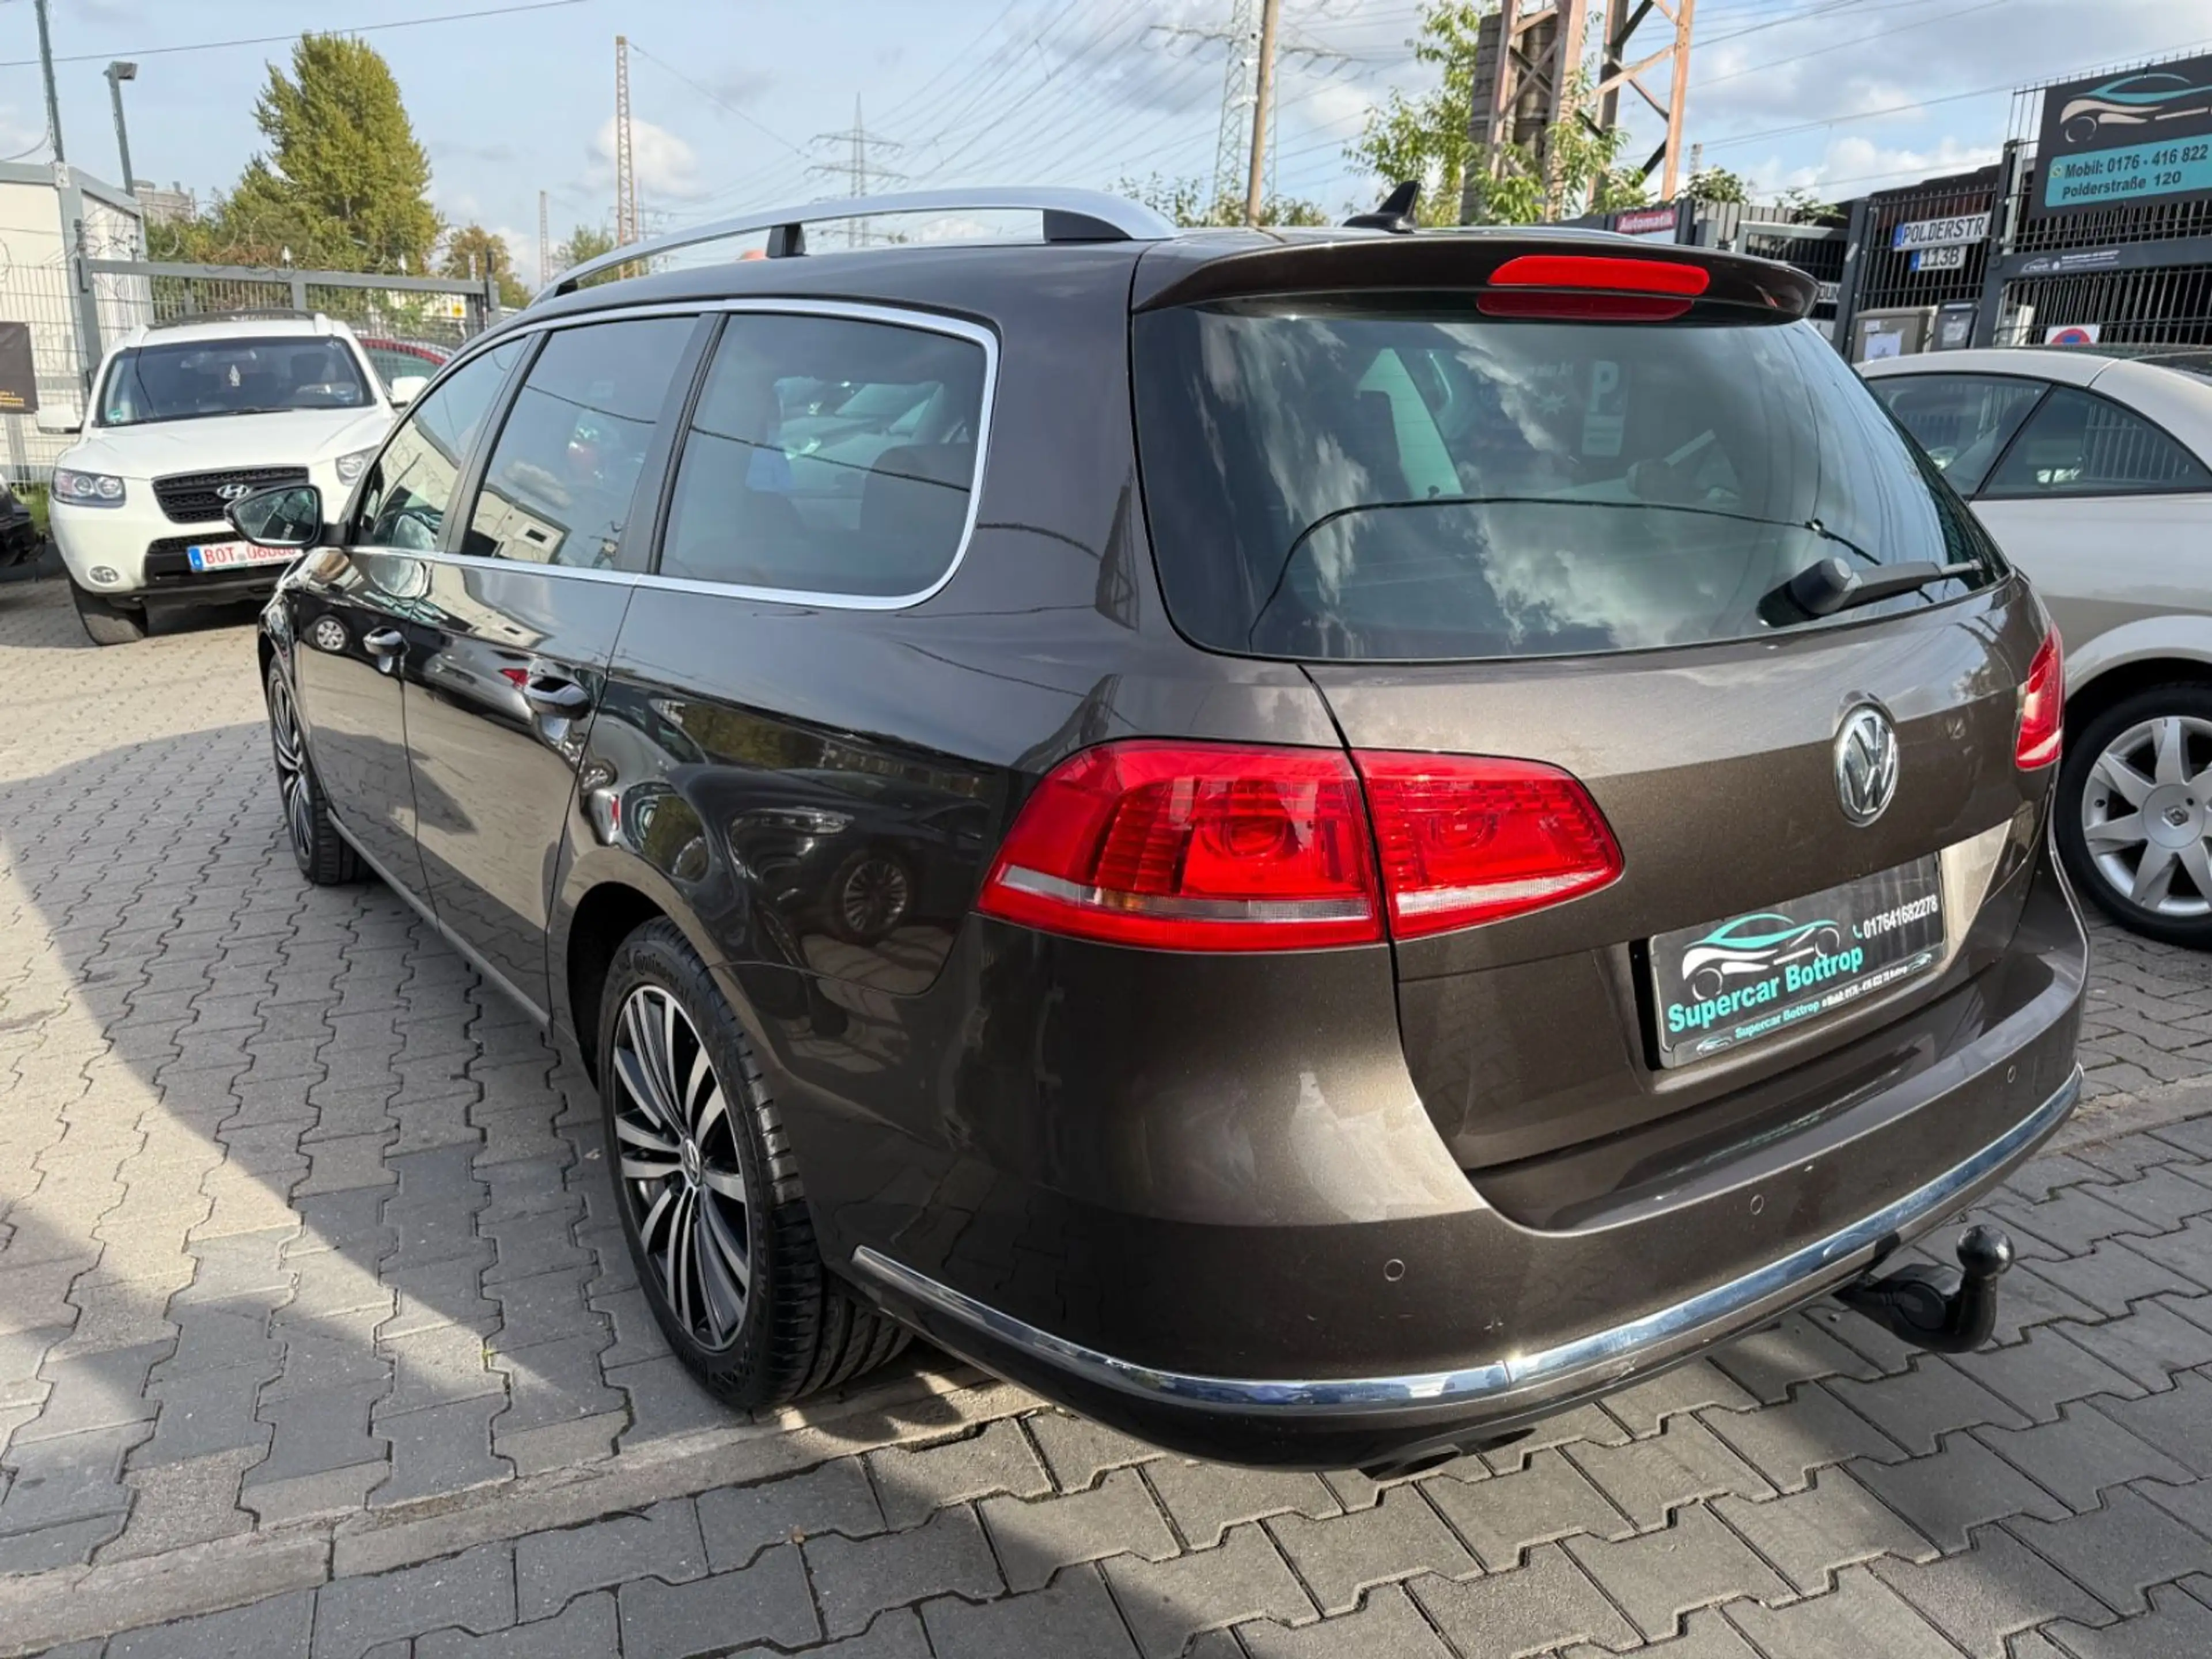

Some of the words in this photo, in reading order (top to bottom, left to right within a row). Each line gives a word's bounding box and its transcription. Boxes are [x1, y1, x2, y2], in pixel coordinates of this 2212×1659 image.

[2064, 159, 2103, 179] Mobil:
[2107, 154, 2140, 173] 0176
[2152, 148, 2177, 166] 416
[2181, 143, 2210, 162] 822
[2062, 175, 2146, 200] Polderstraße
[2153, 171, 2182, 187] 120
[1619, 211, 1673, 232] Automatik
[1902, 216, 1986, 244] POLDERSTR
[1921, 247, 1960, 267] 113B
[204, 546, 236, 565] BOT
[1862, 893, 1938, 939] 017641682278
[1668, 977, 1780, 1032] Supercar
[1785, 946, 1863, 993] Bottrop
[1734, 1014, 1781, 1039] Supercar
[1783, 1001, 1820, 1021] Bottrop
